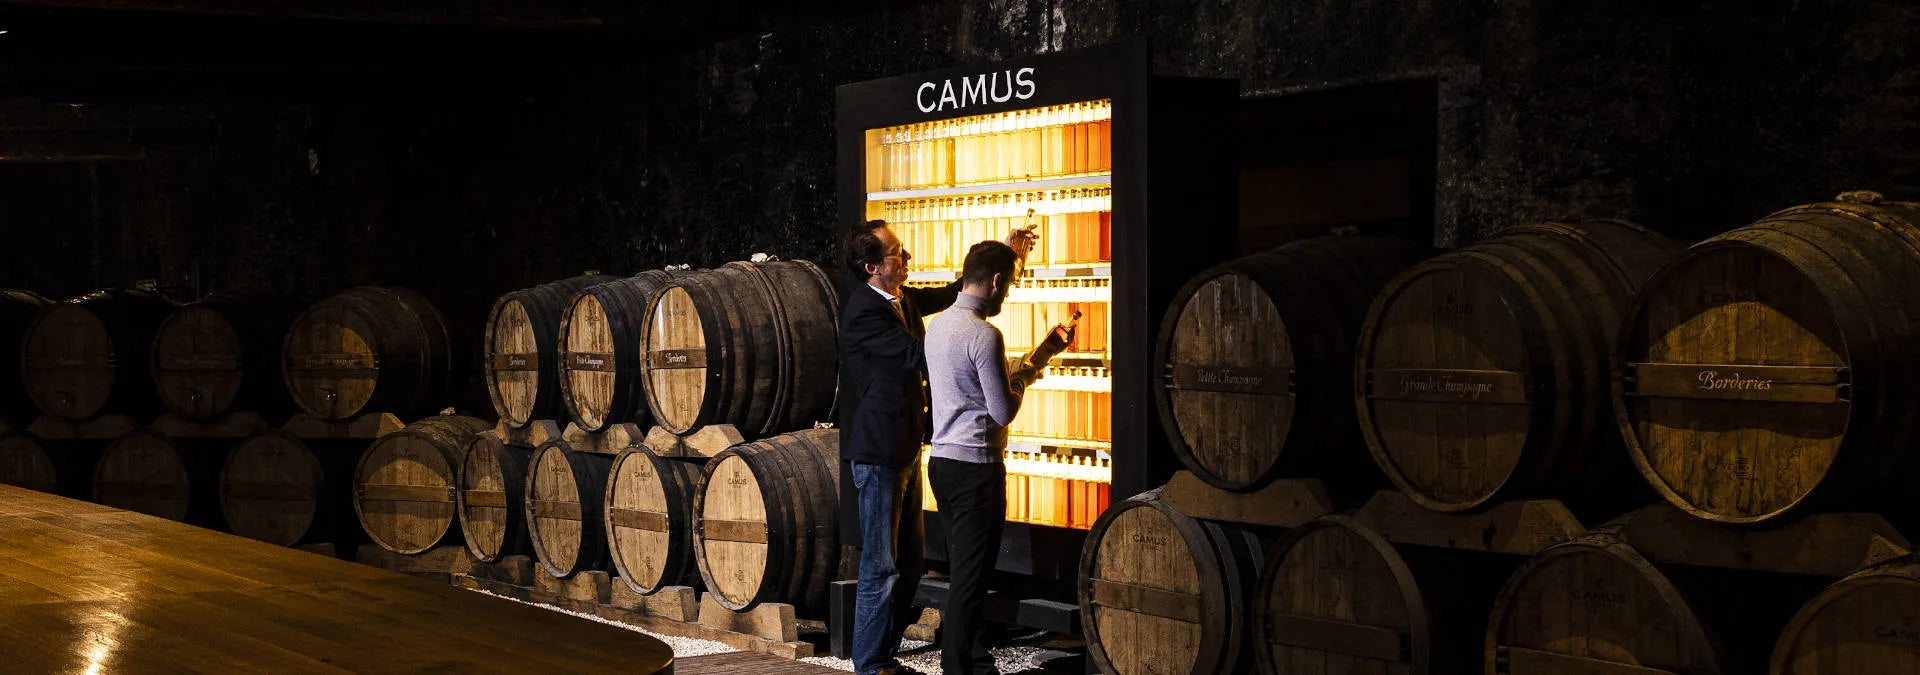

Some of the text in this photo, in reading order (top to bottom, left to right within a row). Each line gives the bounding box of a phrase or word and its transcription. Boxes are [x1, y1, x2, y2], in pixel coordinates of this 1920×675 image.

[917, 67, 1036, 113] CAMUS
[1196, 368, 1263, 390] Petite Champagne
[1400, 376, 1493, 400] Grande Champagne
[1698, 370, 1773, 391] Borderies
[1132, 534, 1167, 546] CAMUS
[1572, 589, 1626, 603] CAMUS
